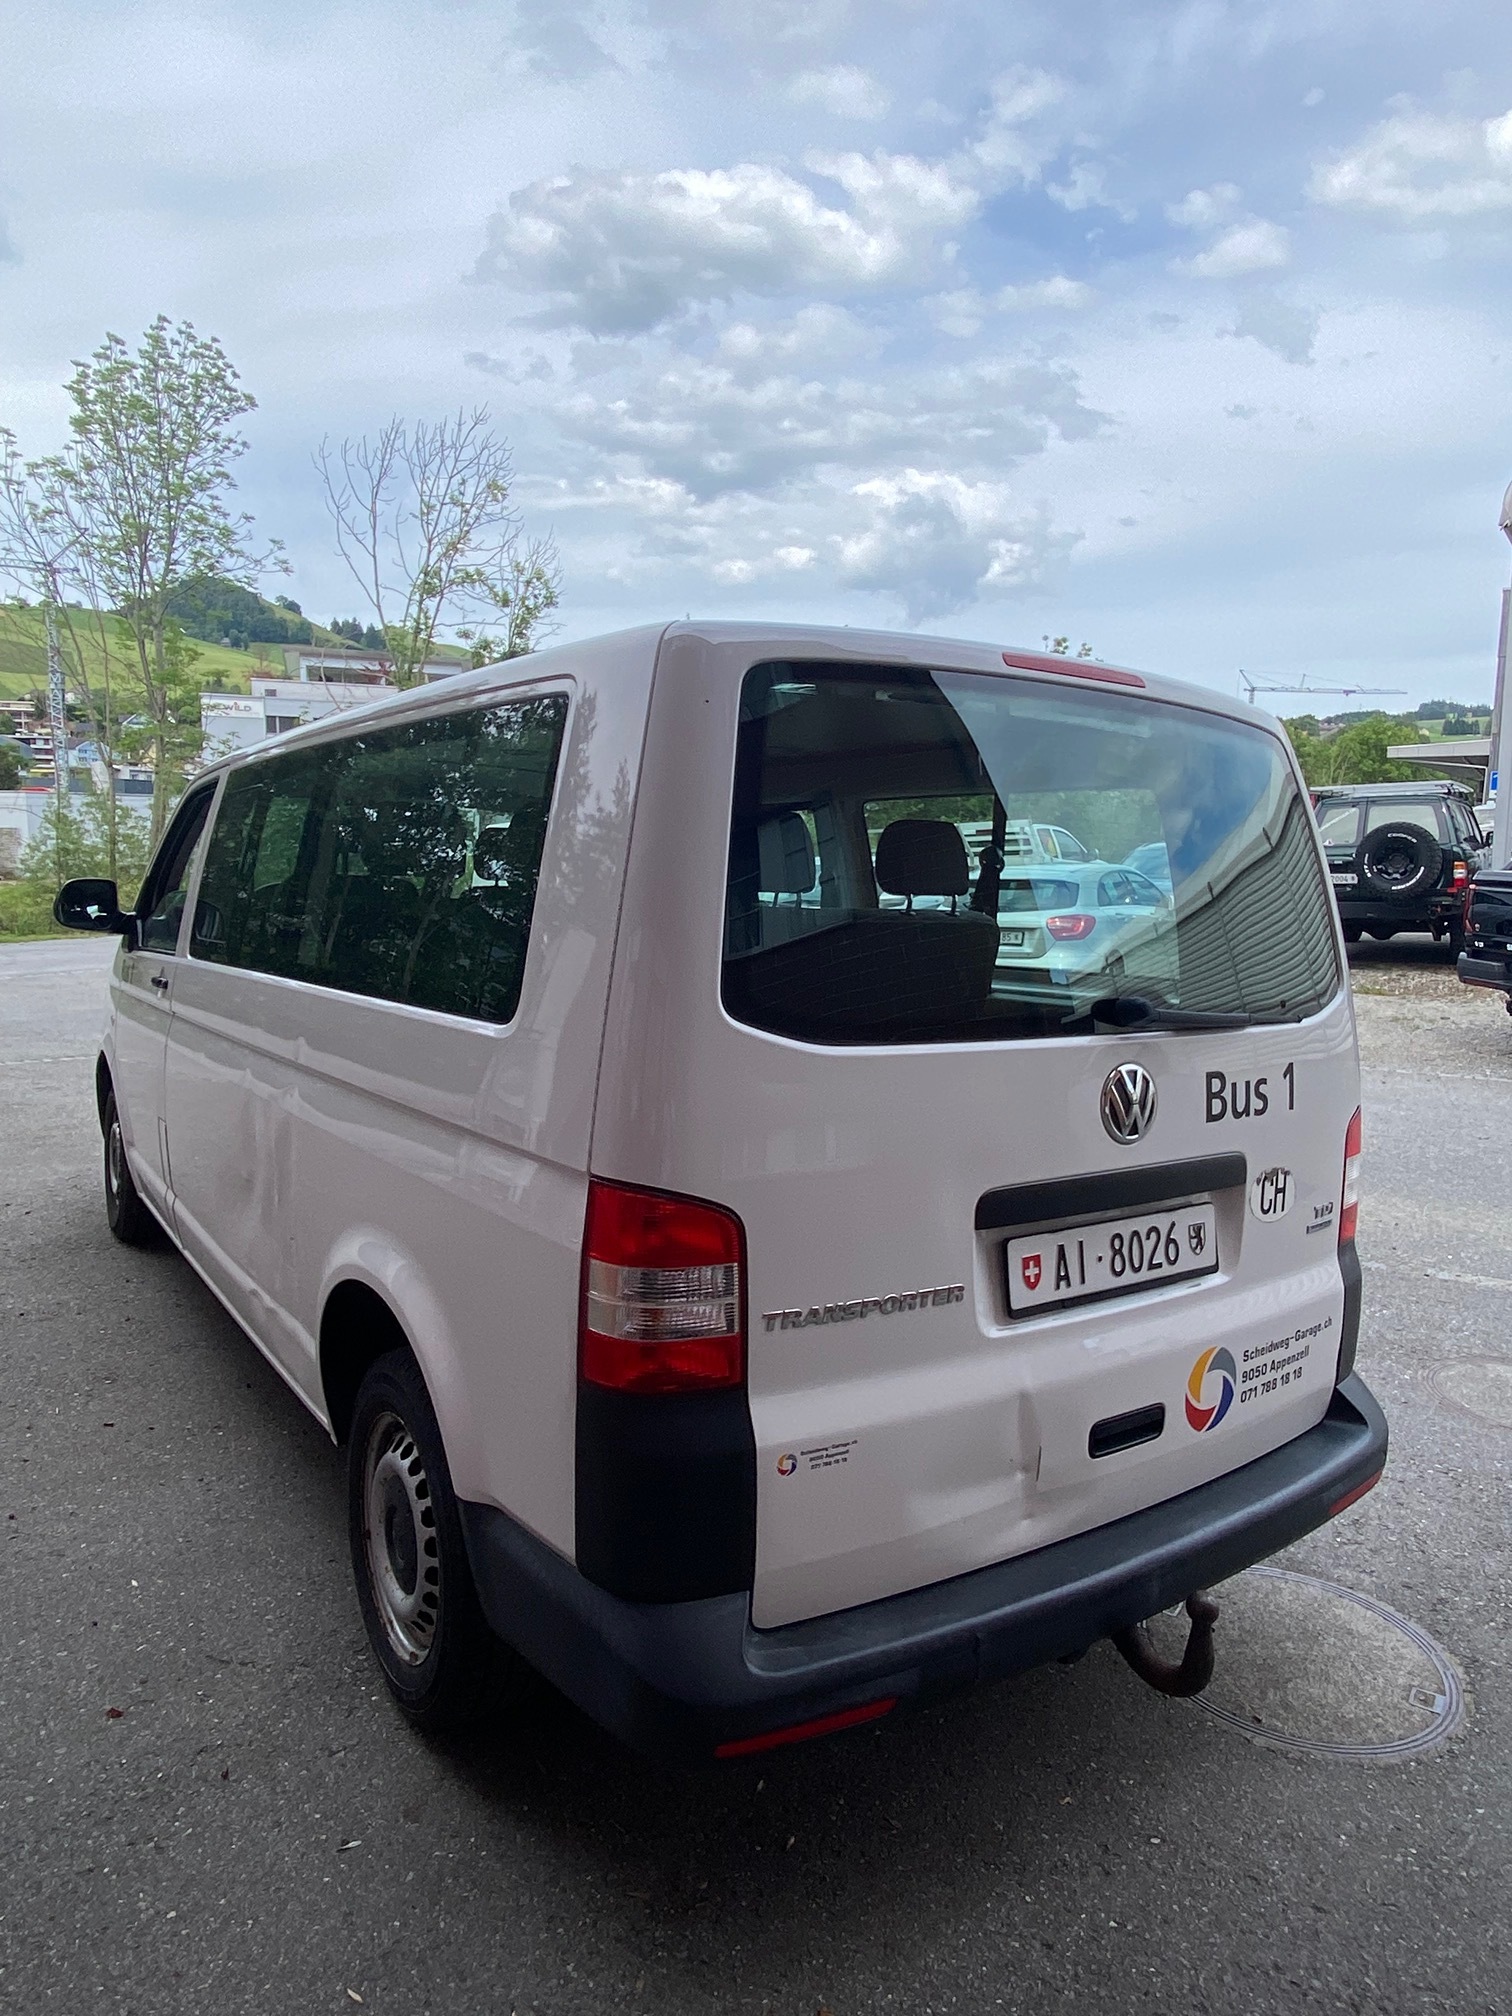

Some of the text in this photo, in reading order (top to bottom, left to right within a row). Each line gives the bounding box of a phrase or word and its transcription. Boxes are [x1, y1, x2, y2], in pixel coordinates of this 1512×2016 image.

[1205, 1062, 1296, 1123] Bus 1
[1259, 1171, 1289, 1216] CH
[761, 1283, 965, 1332] TRANSPORTER
[1242, 1316, 1333, 1362] Scheidweg-Garage.ch
[1240, 1366, 1303, 1404] 071 788 18 18
[1241, 1345, 1310, 1384] 9050 Appenzell
